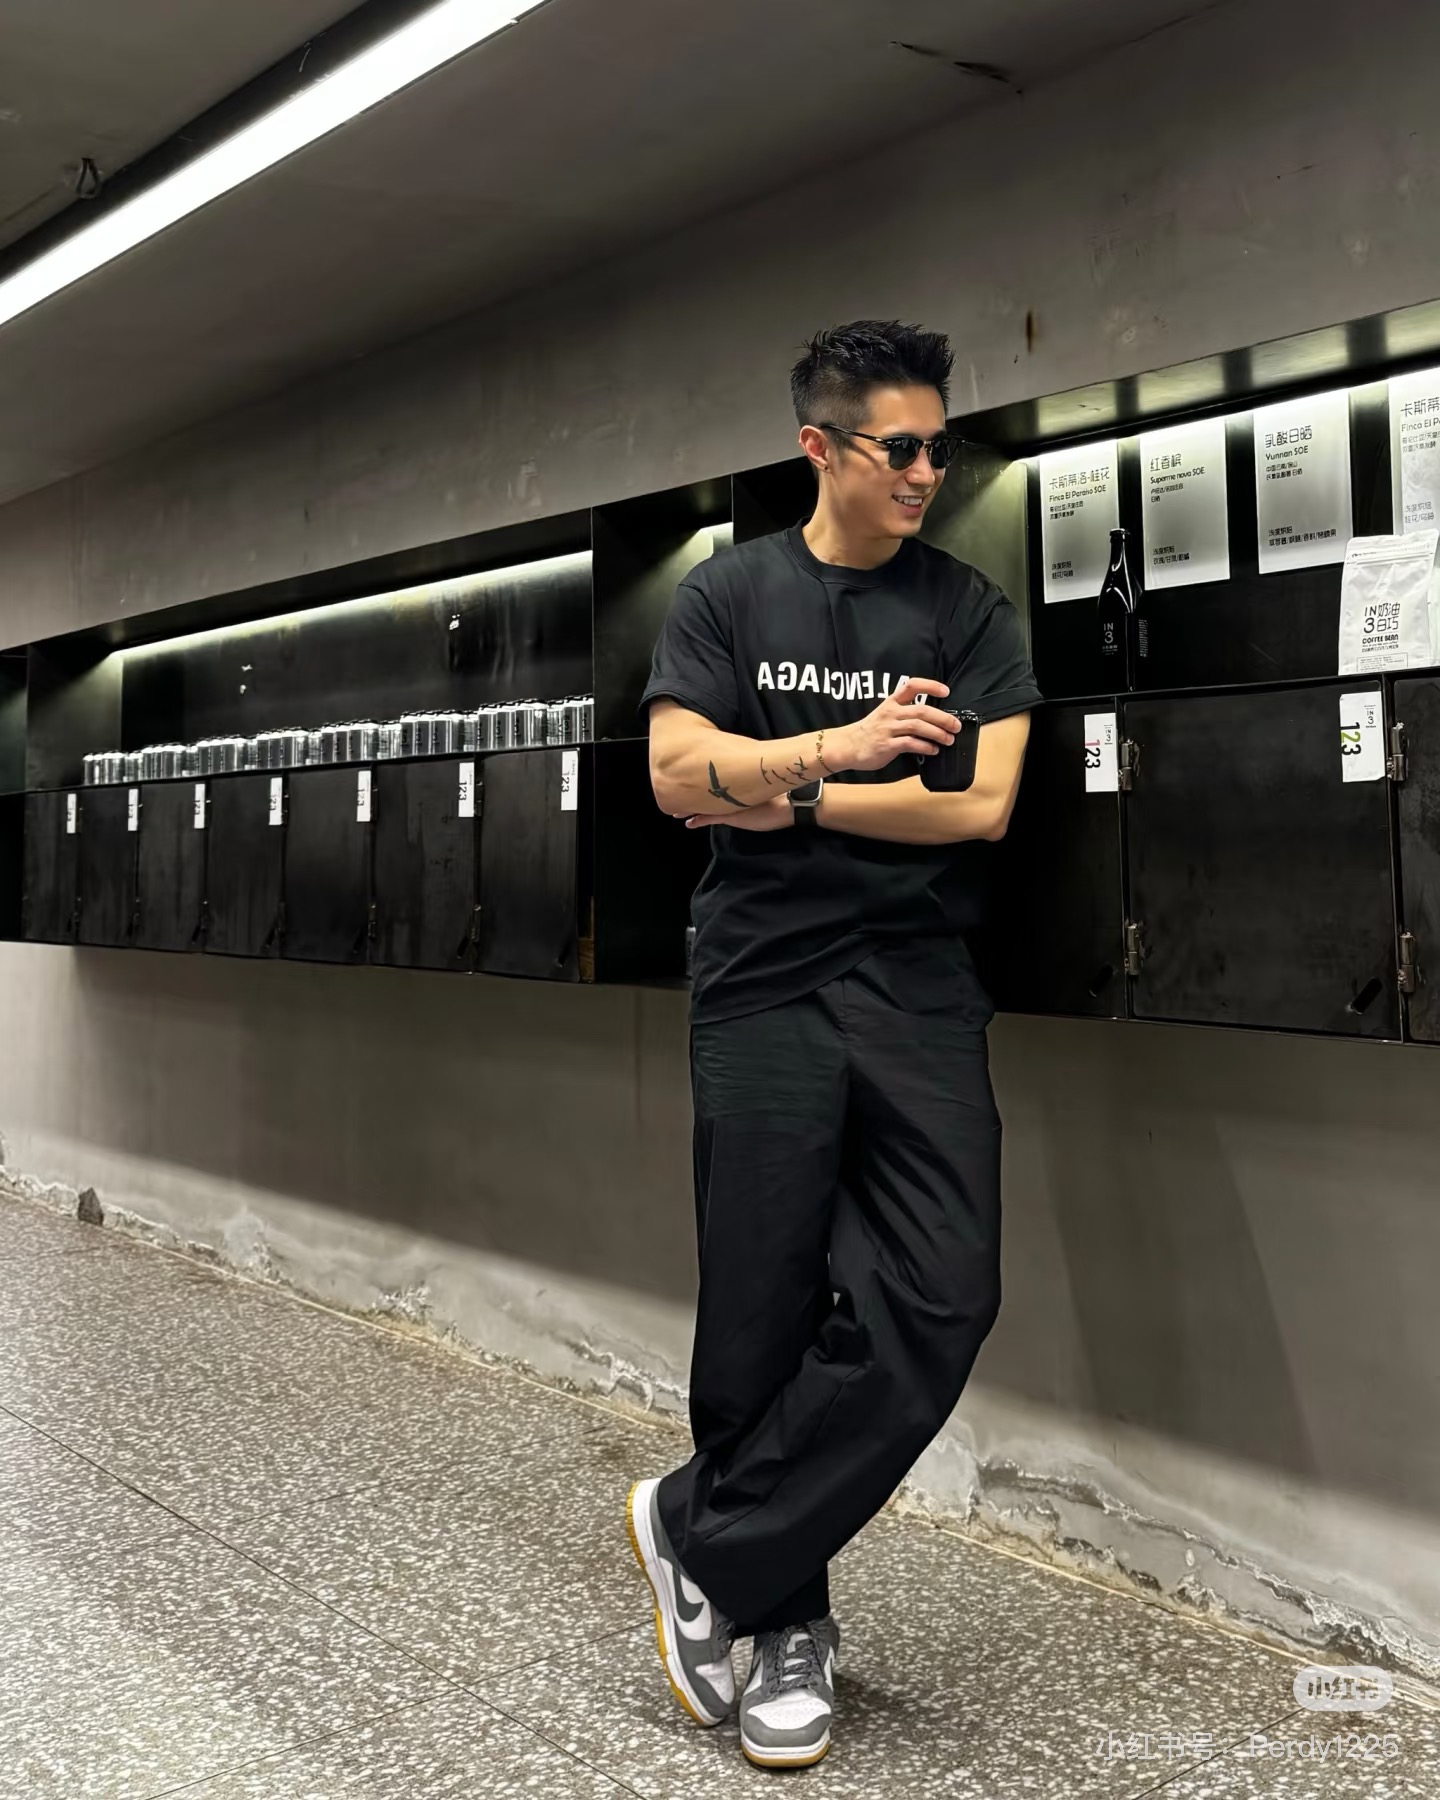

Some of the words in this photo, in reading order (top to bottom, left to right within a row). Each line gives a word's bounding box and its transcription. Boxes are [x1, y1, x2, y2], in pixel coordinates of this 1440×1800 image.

[1424, 419, 1432, 428] El
[1265, 450, 1293, 461] Yunnan
[1294, 445, 1309, 456] SOE
[1176, 471, 1192, 480] nova
[1192, 466, 1206, 477] SOE
[1049, 494, 1065, 503] Finca
[1065, 491, 1071, 500] El
[1093, 484, 1107, 494] SOE
[1364, 605, 1377, 617] IN
[1377, 602, 1401, 618] 奶油
[1103, 622, 1114, 631] IN
[1363, 617, 1375, 633] 3
[1104, 631, 1114, 643] 3
[1367, 715, 1374, 725] 3
[1340, 721, 1361, 756] 123
[1085, 739, 1101, 769] 123
[561, 770, 570, 793] 123
[458, 780, 467, 801] 123
